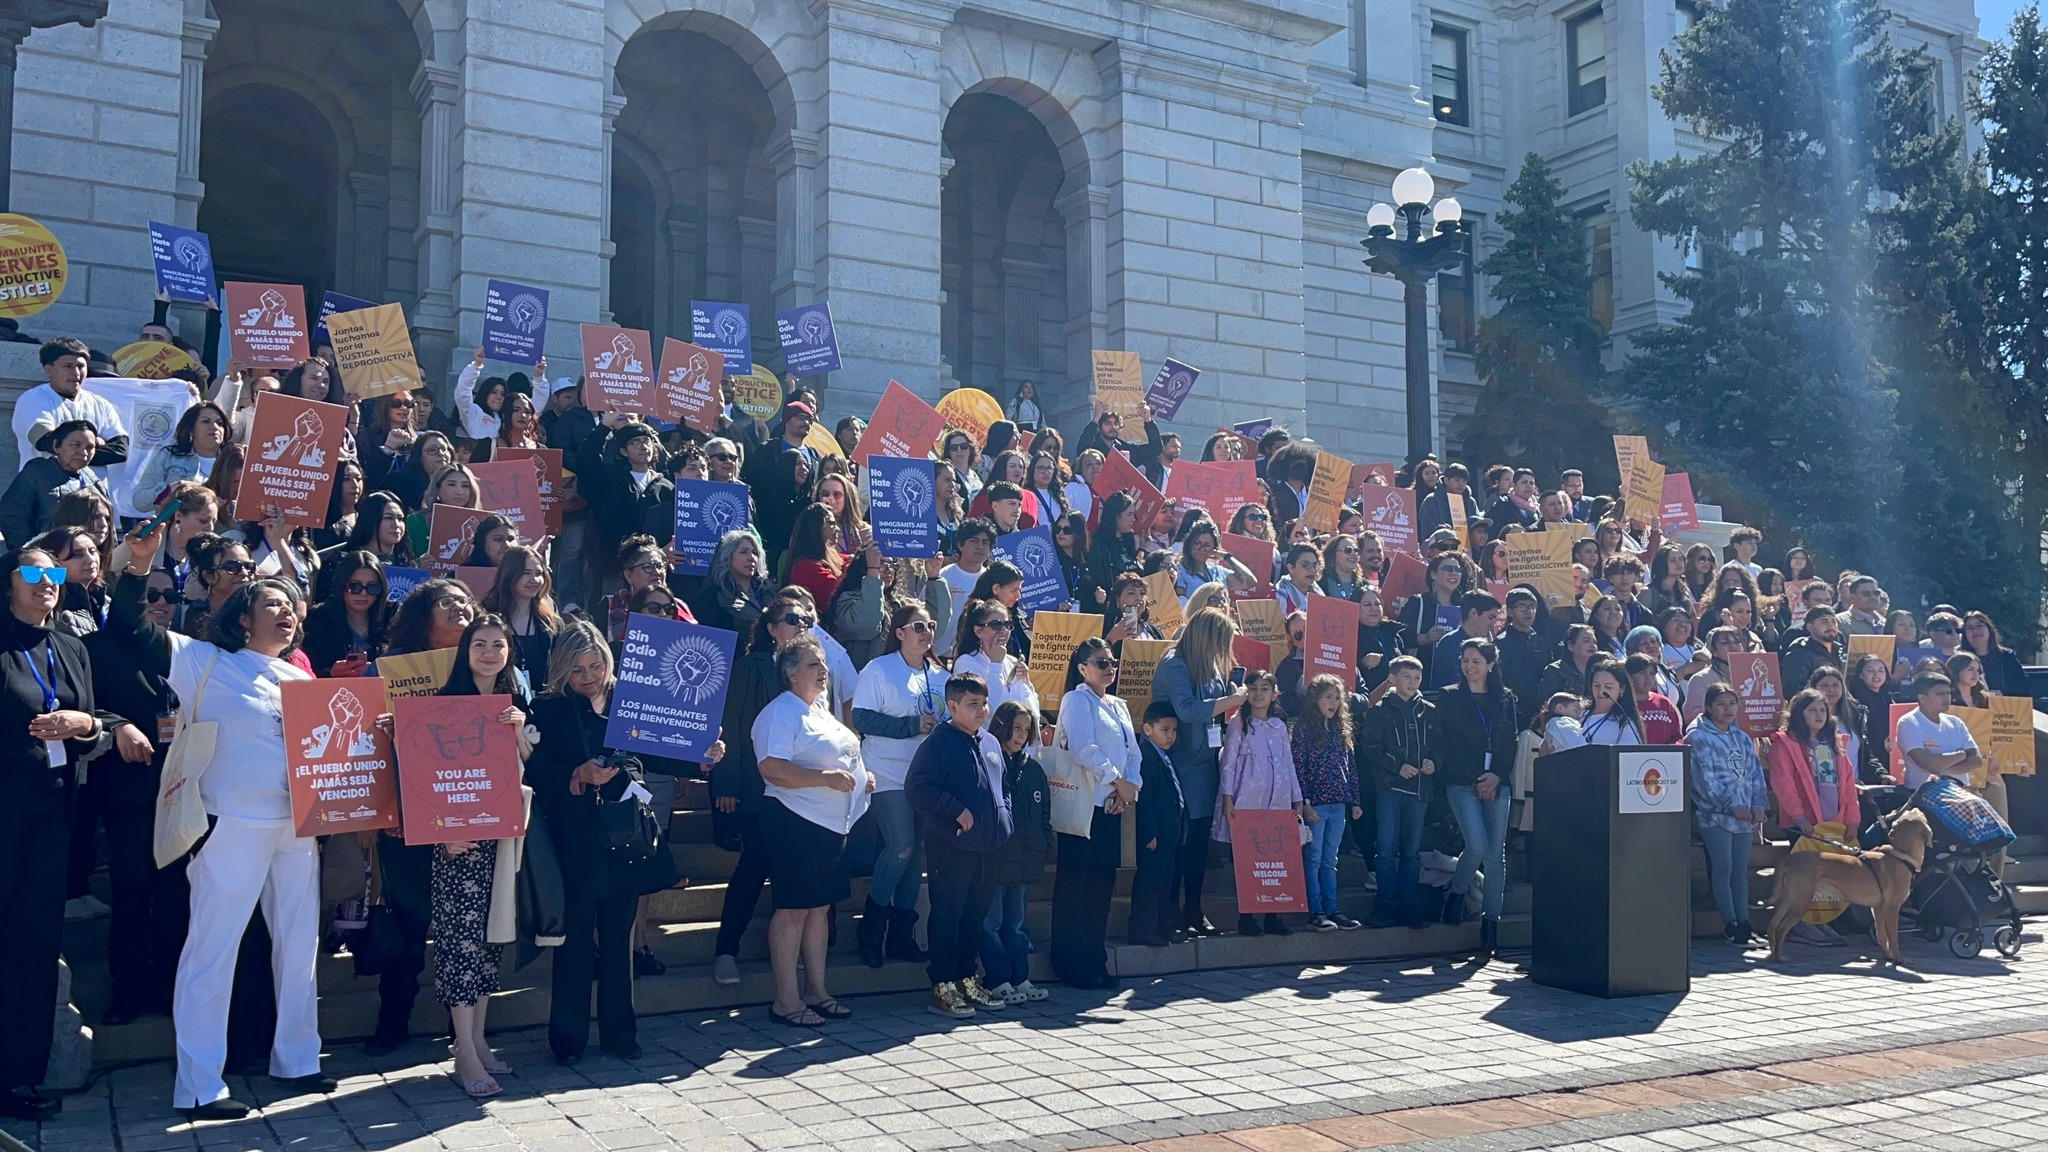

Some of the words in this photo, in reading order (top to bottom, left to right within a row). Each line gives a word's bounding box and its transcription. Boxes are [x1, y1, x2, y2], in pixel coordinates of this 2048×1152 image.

[151, 230, 162, 238] No
[152, 237, 170, 247] Hate
[153, 245, 164, 253] No
[155, 252, 171, 261] Fear
[324, 301, 335, 309] No
[488, 297, 506, 306] Hate
[486, 313, 504, 322] Fear
[333, 325, 364, 336] Juntos
[245, 336, 274, 344] JAMÁS
[335, 331, 380, 344] luchamos
[490, 336, 517, 345] WELCOME
[250, 343, 290, 351] VENCIDO!
[781, 338, 803, 347] Miedo
[338, 344, 354, 354] por
[354, 342, 363, 350] la
[340, 349, 381, 361] JUSTICIA
[342, 351, 413, 370] REPRODUCTIVA
[628, 374, 650, 382] UNIDO
[599, 379, 624, 388] JAMÁS
[625, 381, 642, 389] SERÁ
[604, 387, 638, 396] VENCIDO!
[671, 385, 694, 396] PUEBLO
[694, 392, 714, 402] UNIDO
[667, 391, 689, 402] JAMÁS
[689, 398, 705, 408] SERÁ
[670, 399, 700, 412] VENCIDO!
[945, 401, 960, 413] OUR
[885, 431, 900, 444] YOU
[898, 440, 911, 452] ARE
[250, 463, 264, 472] ¡EL
[265, 464, 300, 477] PUEBLO
[300, 470, 330, 481] UNIDO
[871, 469, 882, 477] No
[259, 476, 293, 488] JAMÁS
[293, 481, 316, 491] SERÁ
[871, 479, 891, 487] Hate
[263, 487, 309, 500] VENCIDO!
[678, 500, 699, 509] Hate
[677, 510, 690, 518] No
[677, 519, 698, 528] Fear
[1376, 523, 1396, 531] PUEBLO
[991, 547, 1005, 556] Sin
[1509, 549, 1542, 557] Together
[994, 554, 1013, 563] Odio
[1520, 556, 1539, 564] fight
[1509, 561, 1570, 571] REPRODUCTIVE
[1509, 571, 1541, 579] JUSTICE
[628, 629, 650, 642] Sin
[1034, 633, 1071, 642] Together
[625, 643, 657, 657] Odio
[1046, 643, 1064, 652] fight
[1065, 643, 1078, 651] for
[1321, 643, 1342, 653] SIEMPRE
[1323, 651, 1340, 660] SERAS
[622, 657, 644, 670] Sin
[1030, 662, 1063, 671] JUSTICE
[1122, 659, 1155, 668] Together
[1314, 657, 1347, 669] BIENVENIDO.
[1132, 669, 1150, 677] fight
[388, 675, 432, 688] Juntos
[620, 670, 661, 687] Miedo
[1117, 688, 1148, 696] JUSTICE
[621, 699, 640, 709] LOS
[642, 703, 707, 721] INMIGRANTES
[617, 709, 637, 720] SON
[640, 713, 708, 731] BIENVENIDOS!
[676, 738, 692, 746] UNIDAS
[296, 765, 312, 778] ¡EL
[312, 762, 352, 774] PUEBLO
[353, 760, 387, 771] UNIDO
[436, 769, 462, 780] YOU
[464, 768, 487, 778] ARE
[310, 776, 348, 789] JAMÁS
[349, 772, 376, 785] SERÁ
[432, 780, 492, 792] WELCOME
[319, 787, 370, 801] VENCIDO!
[447, 793, 480, 803] HERE.
[364, 809, 377, 817] UNIDAS
[1254, 861, 1270, 869] YOU
[1270, 861, 1284, 869] ARE
[1253, 870, 1288, 878] WELCOME
